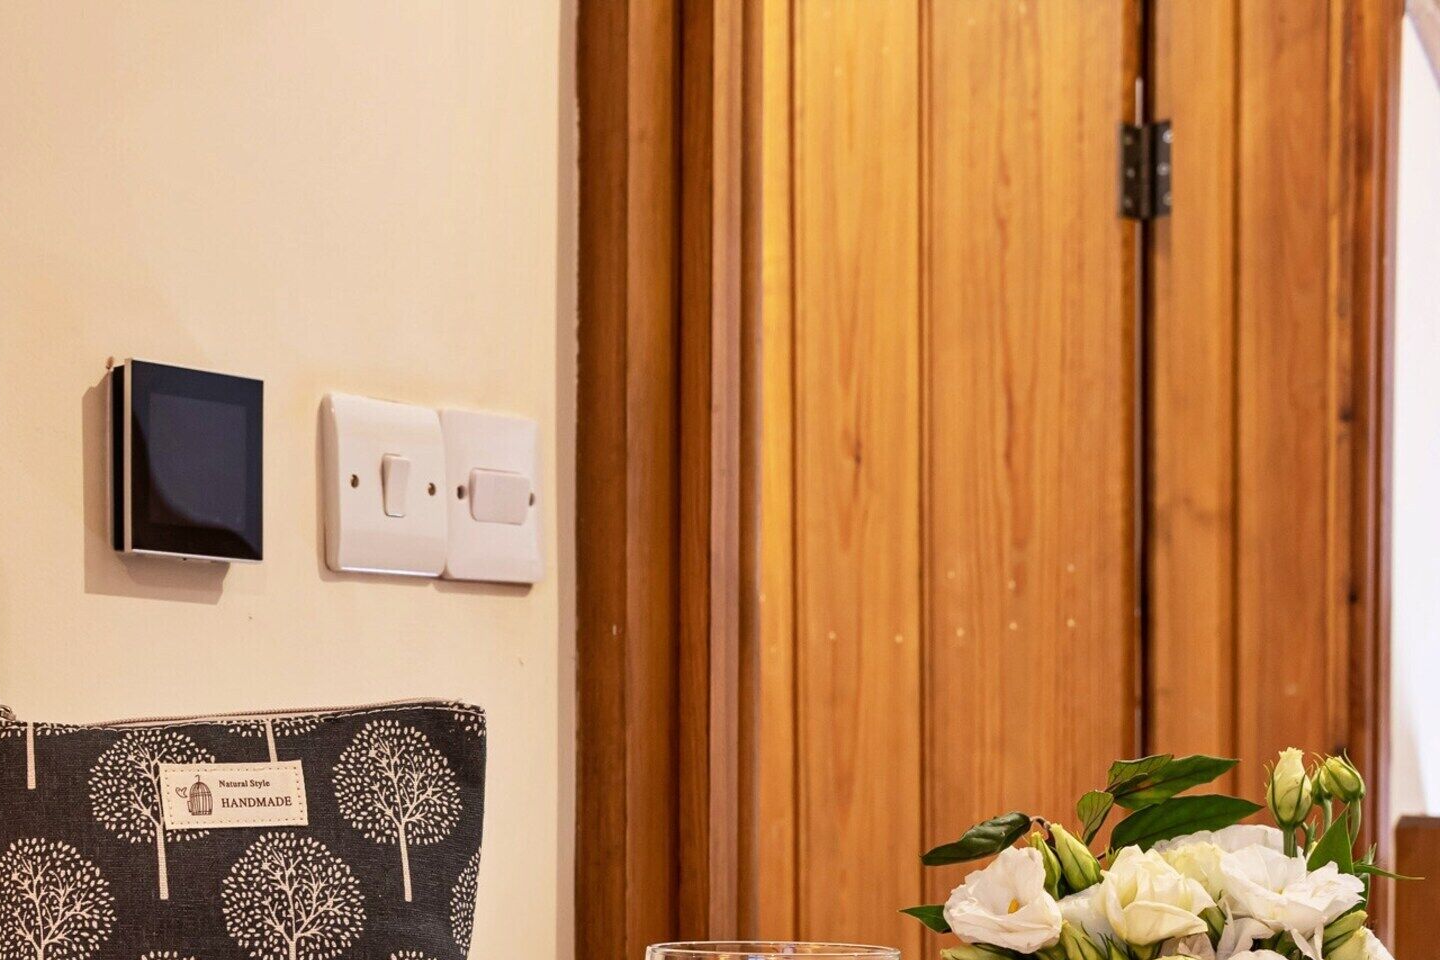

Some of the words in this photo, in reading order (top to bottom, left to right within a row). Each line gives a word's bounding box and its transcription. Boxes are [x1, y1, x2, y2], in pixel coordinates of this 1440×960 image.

[218, 779, 248, 788] Natural
[249, 779, 270, 789] Style
[221, 796, 292, 808] HANDMADE
